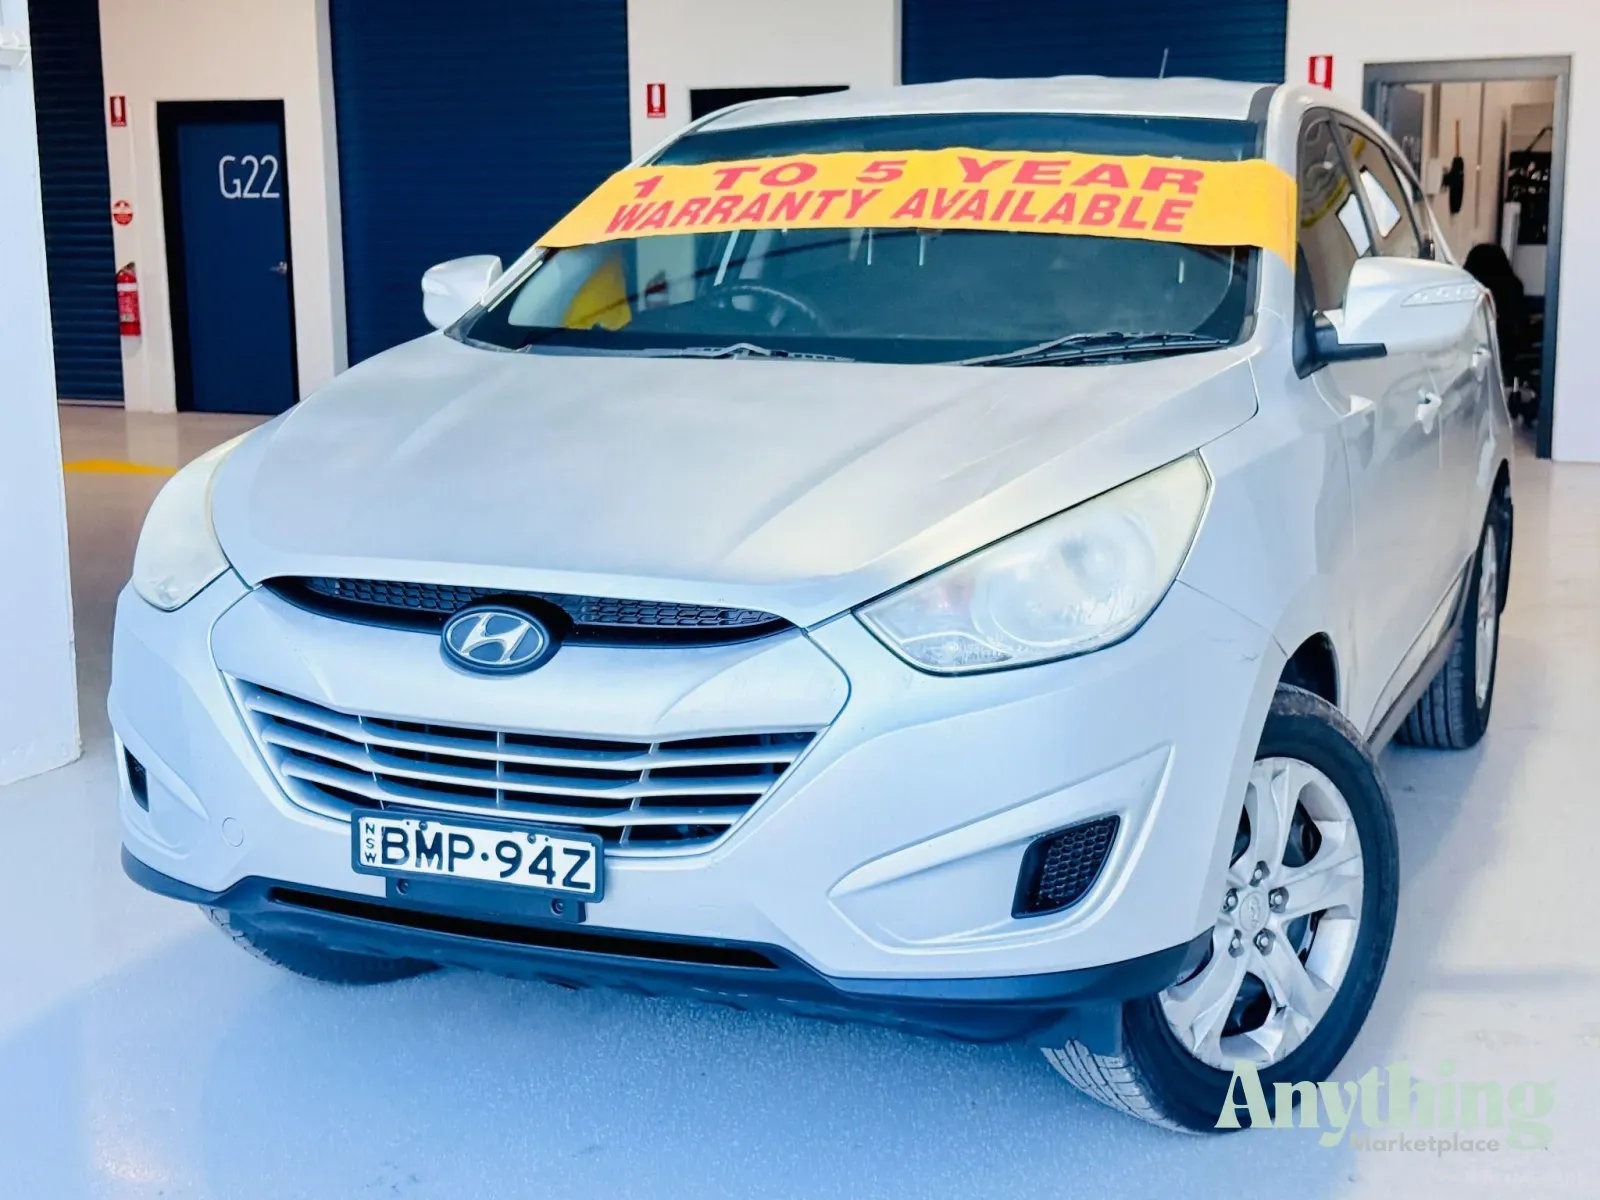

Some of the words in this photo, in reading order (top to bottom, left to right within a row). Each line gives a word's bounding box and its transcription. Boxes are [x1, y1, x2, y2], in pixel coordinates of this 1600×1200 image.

[218, 154, 280, 199] G22
[633, 174, 665, 199] 1
[713, 161, 818, 191] TO
[855, 159, 908, 184] 5
[957, 155, 1205, 195] YEAR
[604, 188, 883, 235] WARRANTY
[890, 187, 1194, 233] AVAILABLE
